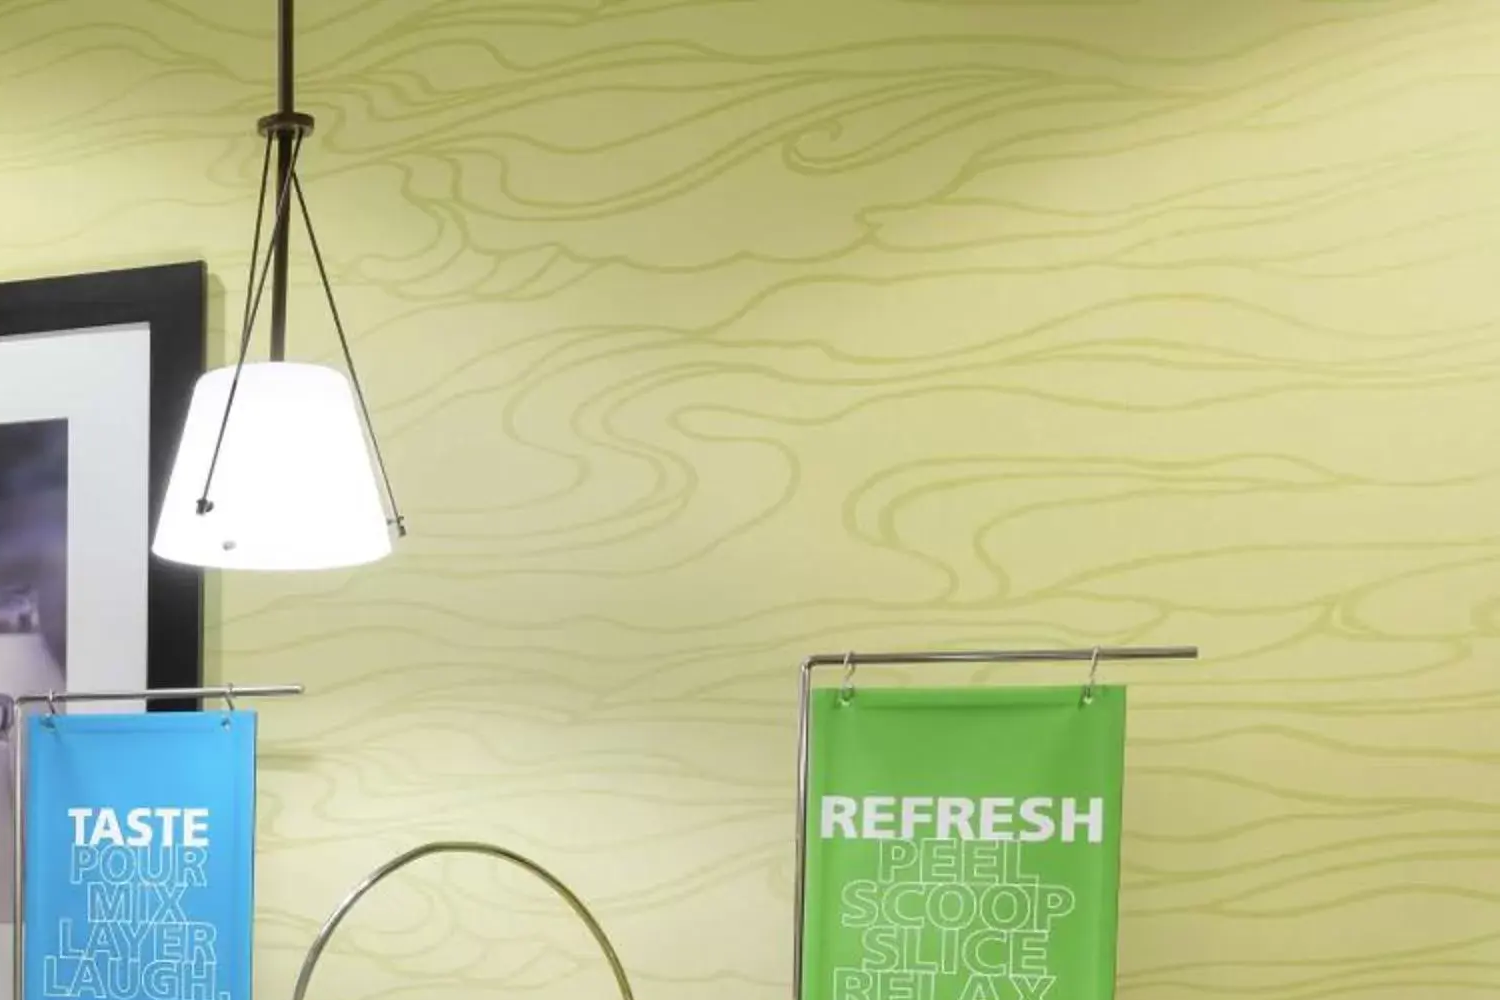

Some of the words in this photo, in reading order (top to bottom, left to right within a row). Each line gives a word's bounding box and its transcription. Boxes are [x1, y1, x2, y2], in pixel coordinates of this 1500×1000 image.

[67, 807, 210, 847] TASTE
[819, 795, 1104, 843] REFRESH
[69, 842, 207, 887] POUR
[877, 837, 1040, 886] PEEL
[86, 881, 188, 923] MIX
[840, 879, 1076, 932] SCOOP
[58, 918, 218, 963] LAYER
[861, 925, 1050, 976] SLICE
